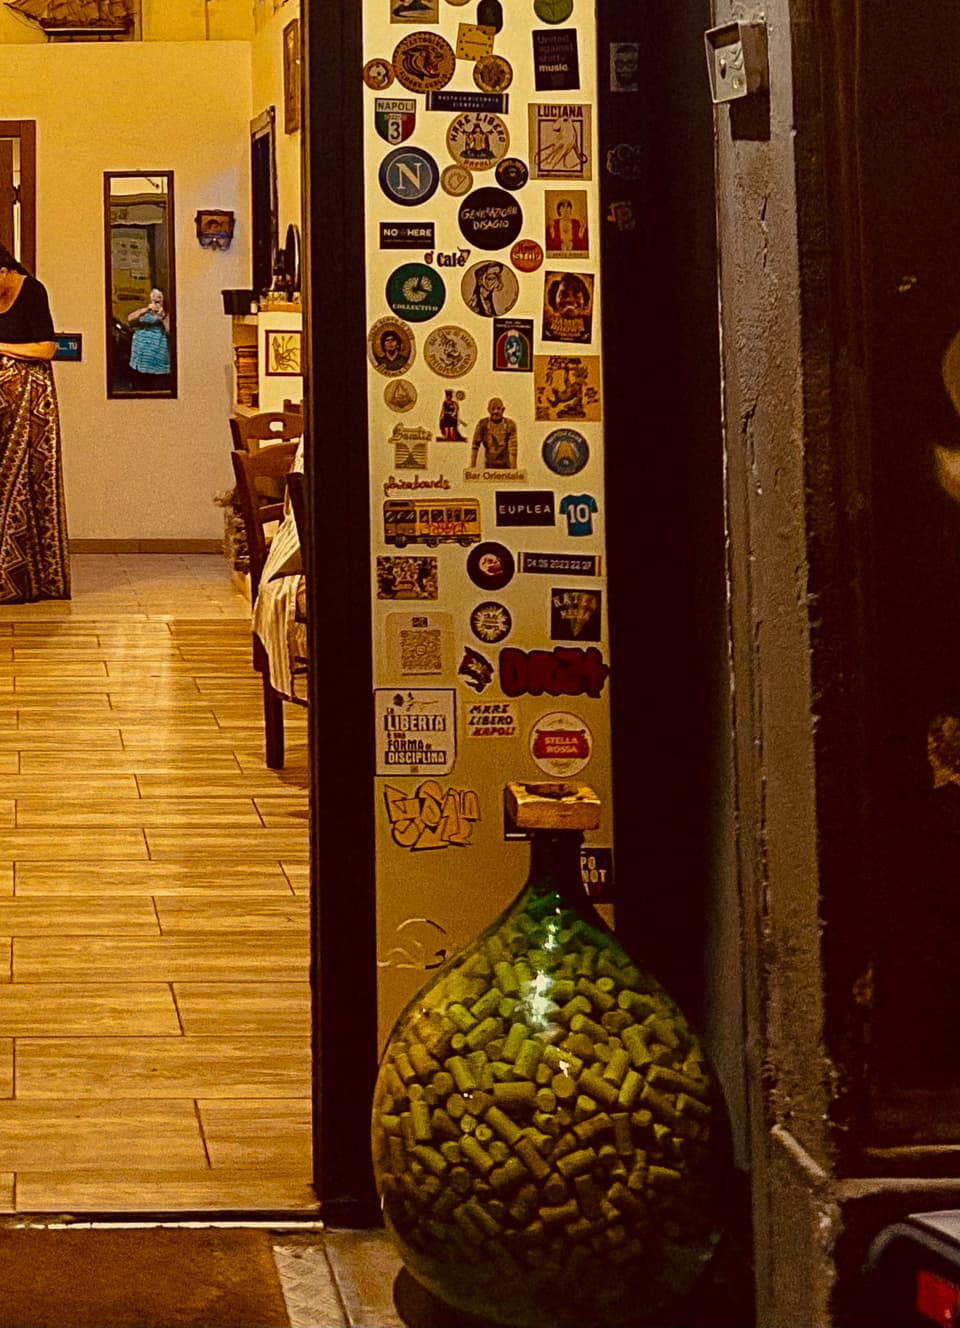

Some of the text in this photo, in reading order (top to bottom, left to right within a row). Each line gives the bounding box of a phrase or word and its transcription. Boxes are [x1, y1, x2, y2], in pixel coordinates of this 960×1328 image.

[539, 63, 569, 72] music
[378, 101, 414, 111] NAPOLI
[537, 104, 583, 118] LUCIANA
[390, 121, 401, 140] 3
[395, 162, 422, 192] N
[472, 218, 510, 231] DISAGIO
[464, 471, 525, 480] Bar Orientale
[498, 505, 551, 514] EUPLEA
[568, 504, 590, 523] 10
[469, 704, 510, 714] MARE
[468, 715, 514, 726] LIBERO
[473, 727, 516, 736] NAPOLI
[387, 739, 424, 751] FORMA
[544, 736, 579, 745] STELLA
[545, 745, 579, 754] ROSSA
[388, 752, 445, 764] DISCIPLINA
